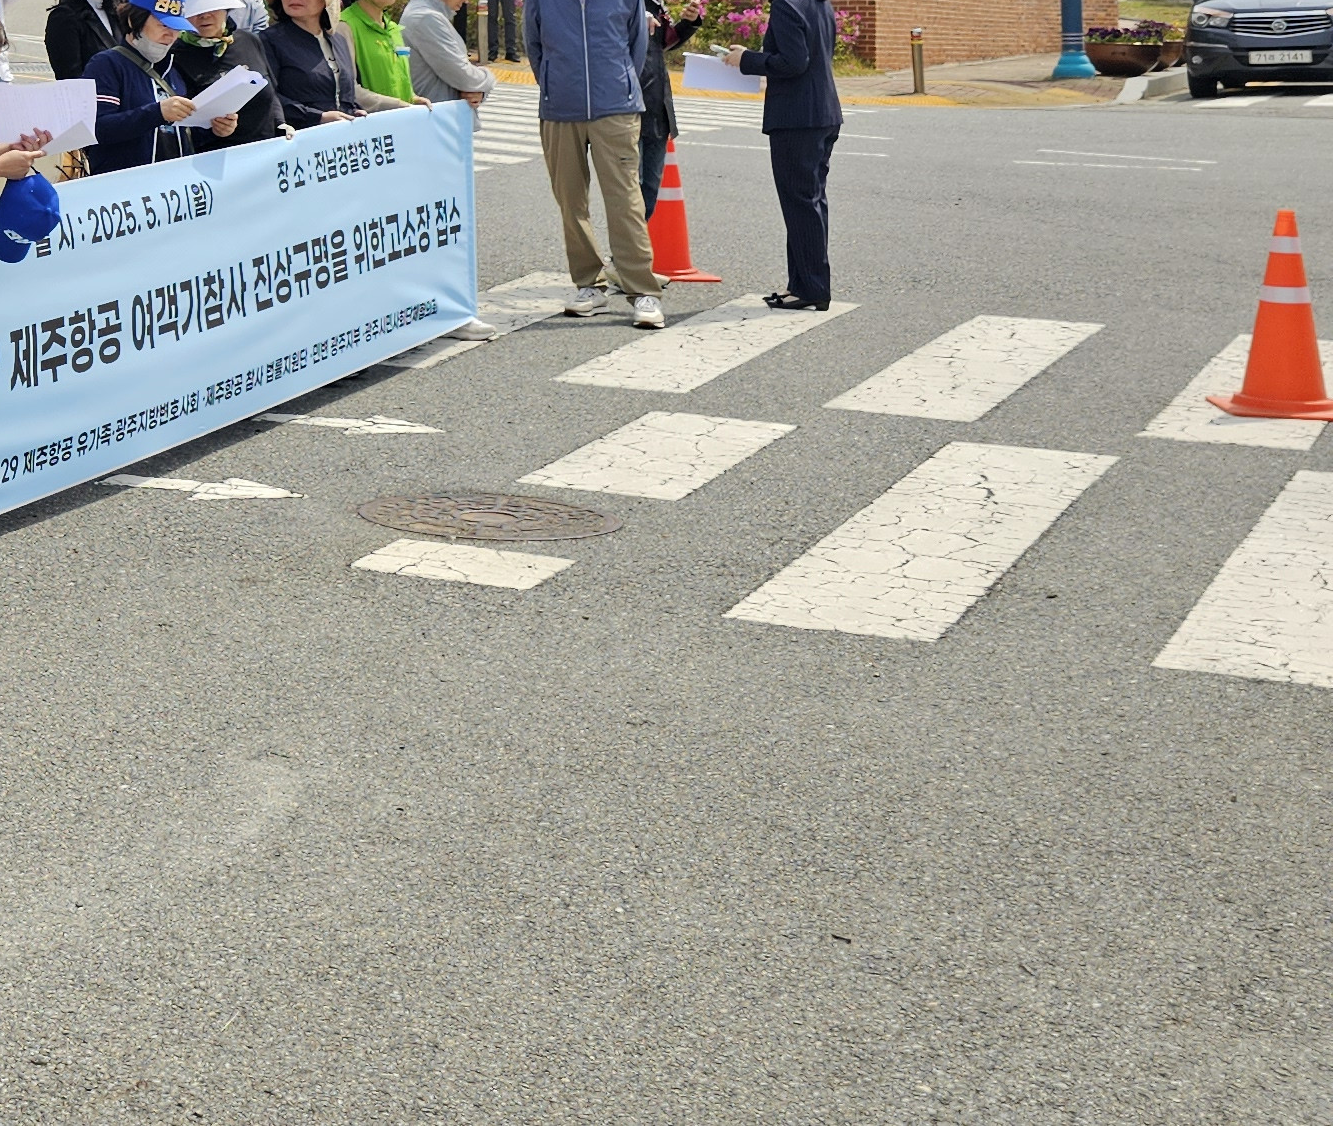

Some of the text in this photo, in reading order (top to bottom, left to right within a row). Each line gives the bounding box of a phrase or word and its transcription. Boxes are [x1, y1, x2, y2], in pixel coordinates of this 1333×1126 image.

[314, 139, 371, 183] 전남경찰청
[371, 134, 396, 166] 정문
[87, 200, 141, 244] 2025.
[9, 299, 122, 391] 제주항공
[131, 261, 247, 351] 여객기참사
[251, 228, 349, 313] 진상규명을
[434, 196, 462, 248] 접수
[23, 436, 73, 476] 제주항공
[245, 364, 264, 392] 참사
